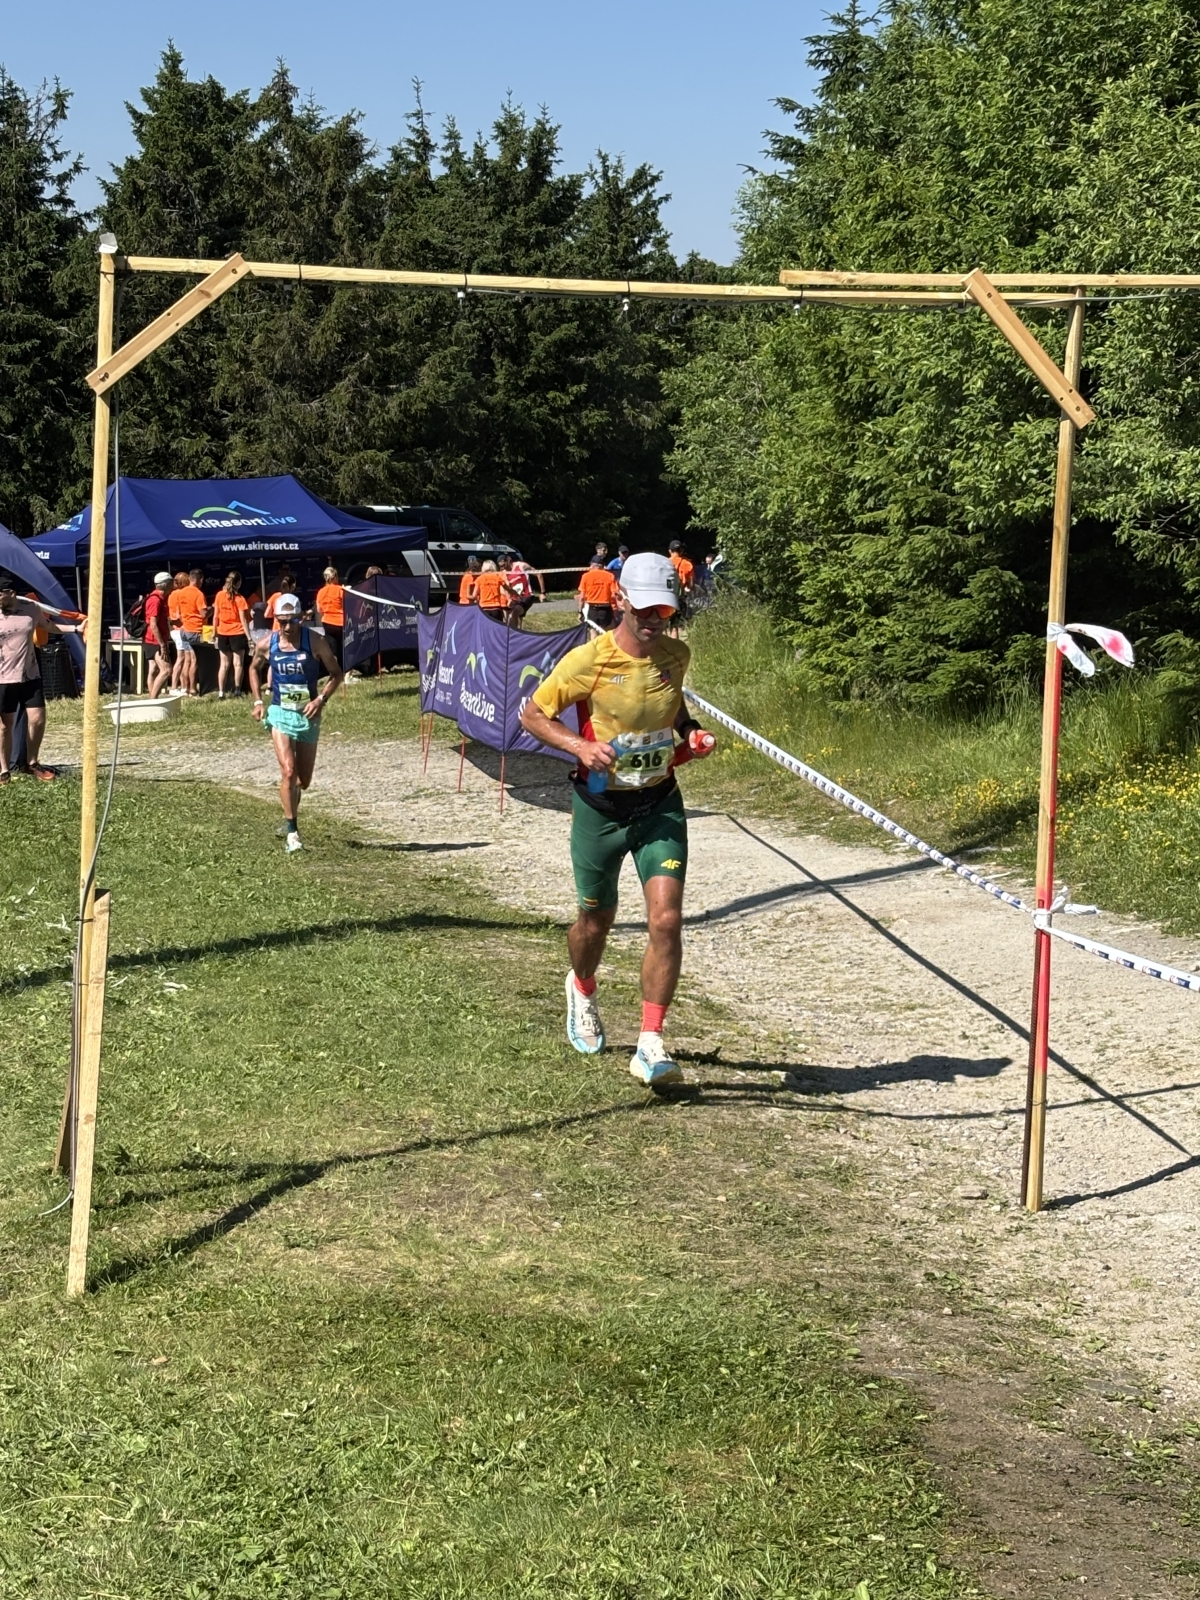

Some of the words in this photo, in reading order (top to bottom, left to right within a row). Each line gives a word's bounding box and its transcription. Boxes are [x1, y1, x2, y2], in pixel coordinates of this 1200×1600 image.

[180, 515, 298, 530] SkiResortLive
[221, 540, 300, 552] www.skiresort.cz
[277, 662, 305, 676] USA
[630, 750, 663, 769] 616
[660, 858, 682, 870] 4F
